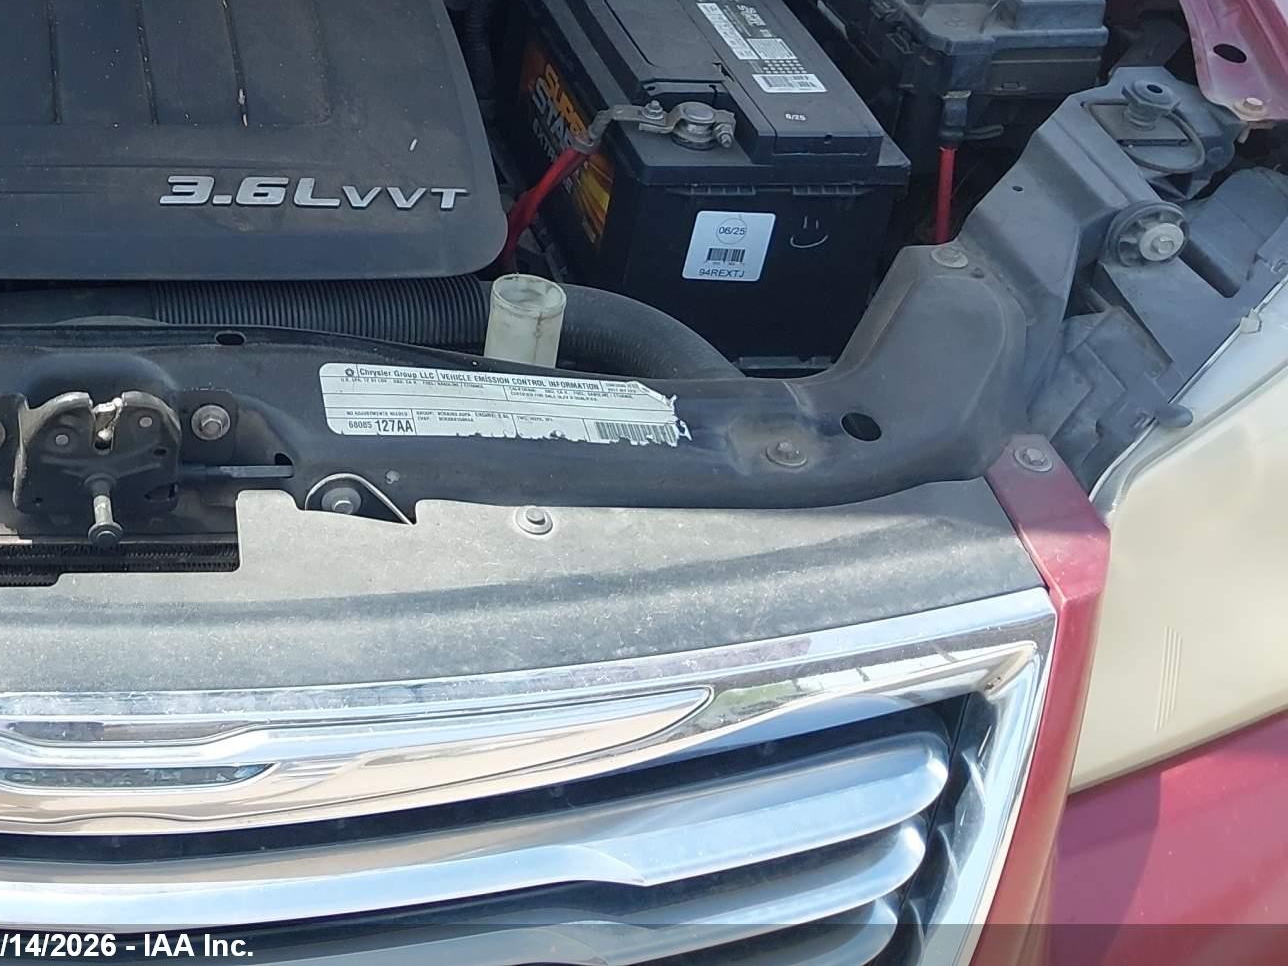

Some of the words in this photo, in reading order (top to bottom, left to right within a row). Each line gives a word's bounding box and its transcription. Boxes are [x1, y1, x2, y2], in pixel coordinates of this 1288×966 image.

[544, 62, 589, 140] SUPE
[718, 226, 746, 235] 06/25
[698, 268, 745, 278] 94REXTJ
[359, 368, 392, 378] Chrysler
[393, 369, 417, 379] Group
[419, 371, 435, 379] LLC
[440, 372, 471, 382] VEHICLE
[473, 375, 510, 384] EMISSION
[511, 377, 546, 387] CONTROL
[548, 379, 600, 390] INFORMATION
[348, 420, 373, 429] 68085
[374, 419, 414, 432] 127AA
